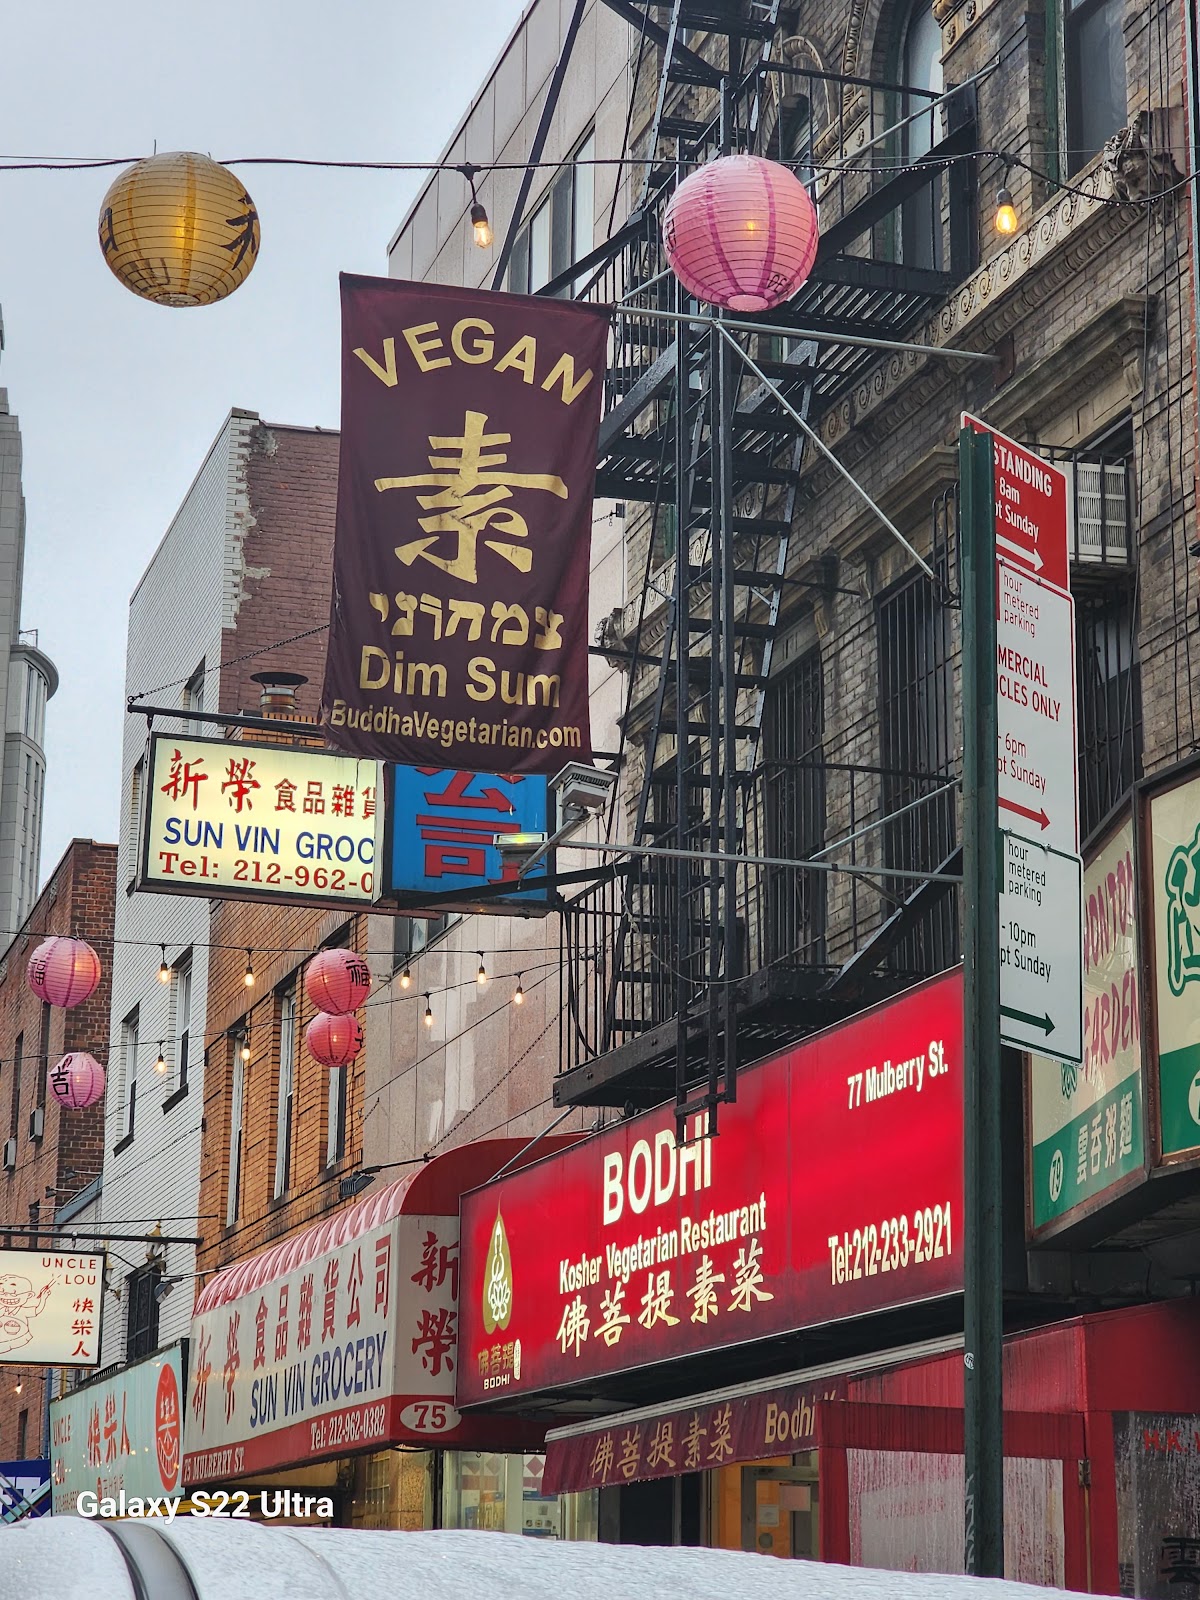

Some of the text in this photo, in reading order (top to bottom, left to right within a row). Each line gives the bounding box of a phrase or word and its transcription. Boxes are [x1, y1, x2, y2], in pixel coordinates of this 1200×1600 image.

[353, 317, 594, 406] VEGAN
[374, 410, 568, 584] 素
[1000, 477, 1020, 505] 8am
[1005, 504, 1039, 543] Sunday
[1004, 571, 1023, 594] hour
[1004, 592, 1039, 620] metered
[1004, 610, 1035, 638] parking
[359, 645, 560, 708] Dim Sum
[330, 699, 581, 749] BuddhaVegetarian.com
[1032, 691, 1061, 722] ONLY
[1005, 732, 1026, 758] 6pm
[1010, 759, 1046, 795] Sunday
[163, 817, 223, 849] SUN
[235, 823, 281, 855] VIN
[1009, 839, 1028, 861] hour
[158, 851, 220, 879] Tel:
[1009, 862, 1045, 886] metered
[1009, 880, 1041, 906] parking
[1009, 921, 1036, 948] 10pm
[1000, 945, 1051, 983] pt Sunday
[847, 1040, 948, 1109] 77 Mulberry St.
[603, 1111, 711, 1226] BODHI
[1048, 1158, 1061, 1202] 79
[559, 1191, 767, 1294] Kosher Vegetarian Restaurant
[828, 1201, 952, 1286] Tel:212-233-2921
[42, 1257, 97, 1270] UNCLE
[65, 1274, 96, 1285] LOU
[411, 1231, 459, 1377] 新榮
[556, 1238, 774, 1357] 佛菩提素菜
[250, 1330, 387, 1429] SUN VIN GROCERY
[483, 1374, 510, 1390] BODHI
[53, 1414, 71, 1447] UNCLE
[311, 1404, 386, 1451] Tel: 212-962-0382
[413, 1405, 447, 1429] 75
[764, 1397, 816, 1444] Bodhi
[589, 1403, 734, 1483] 佛菩提素菜
[183, 1447, 245, 1482] 75 MULBERRY ST.
